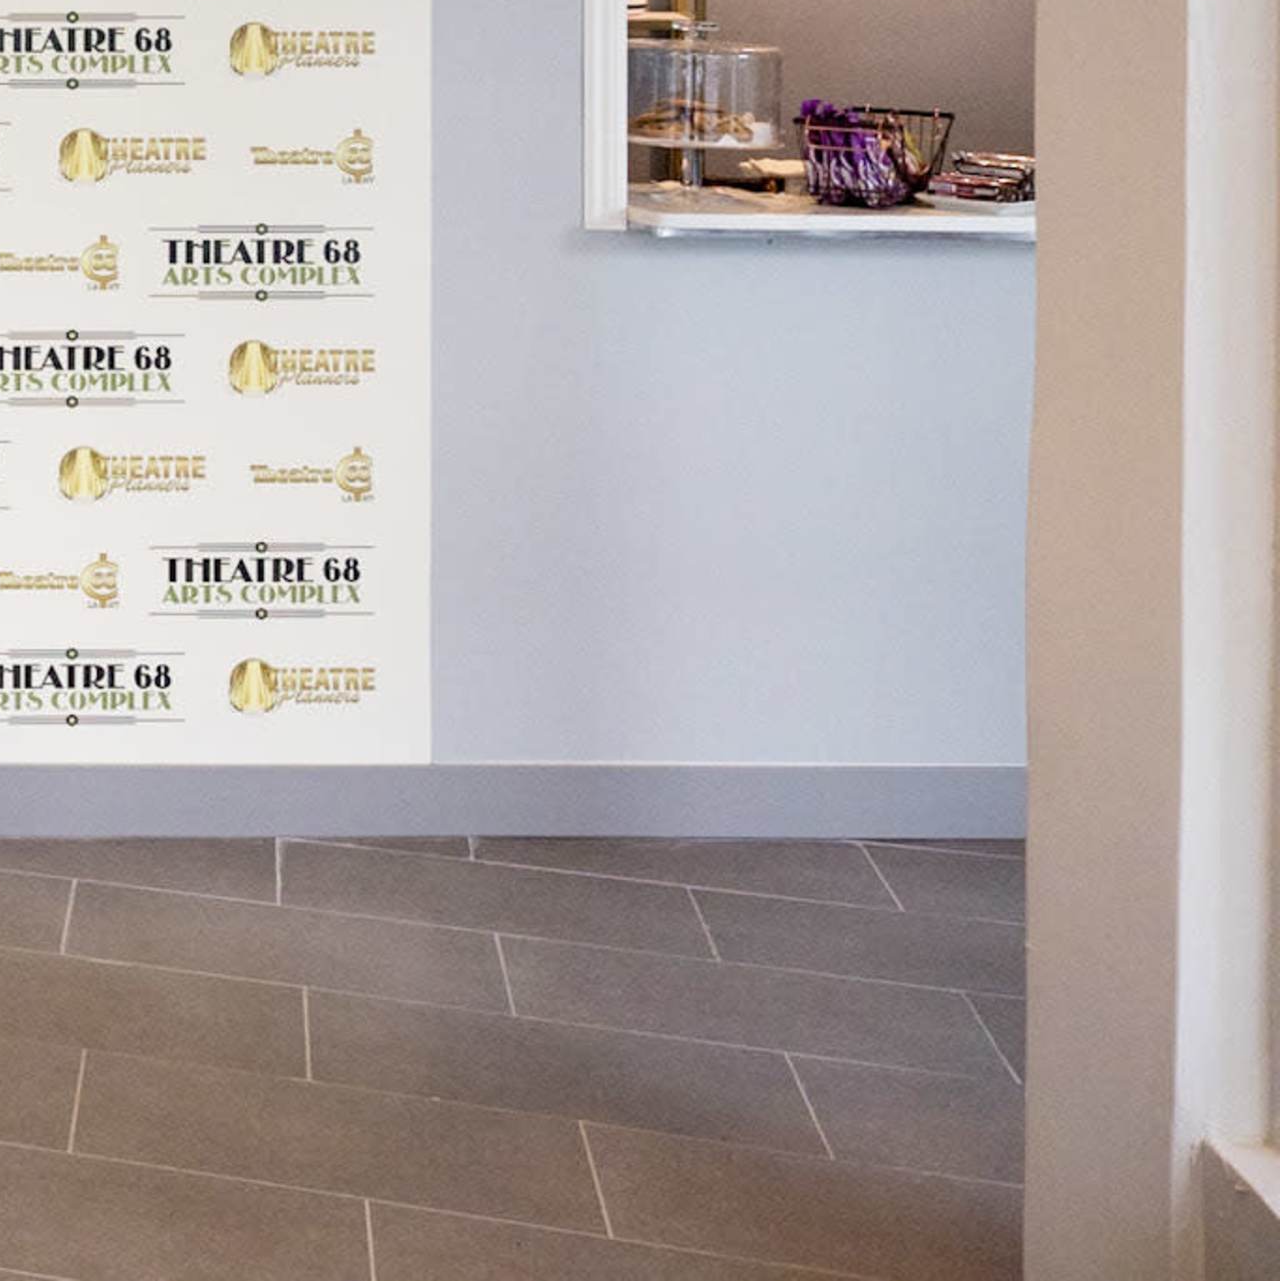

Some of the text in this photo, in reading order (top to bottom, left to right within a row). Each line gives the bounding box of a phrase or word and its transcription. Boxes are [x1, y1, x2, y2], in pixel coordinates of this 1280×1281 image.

[135, 27, 173, 53] 68
[270, 30, 376, 55] THEATRE
[51, 55, 173, 74] COMPLEX
[100, 137, 206, 162] THEATRE
[161, 238, 362, 265] THEATRE 68
[161, 266, 362, 285] ARTS COMPLEX
[135, 345, 173, 371] 68
[270, 348, 376, 373] THEATRE
[51, 373, 173, 392] COMPLEX
[100, 455, 206, 480] THEATRE
[161, 557, 362, 584] THEATRE 68
[161, 585, 362, 604] ARTS COMPLEX
[135, 663, 173, 689] 68
[270, 667, 376, 692] THEATRE
[51, 691, 173, 710] COMPLEX
